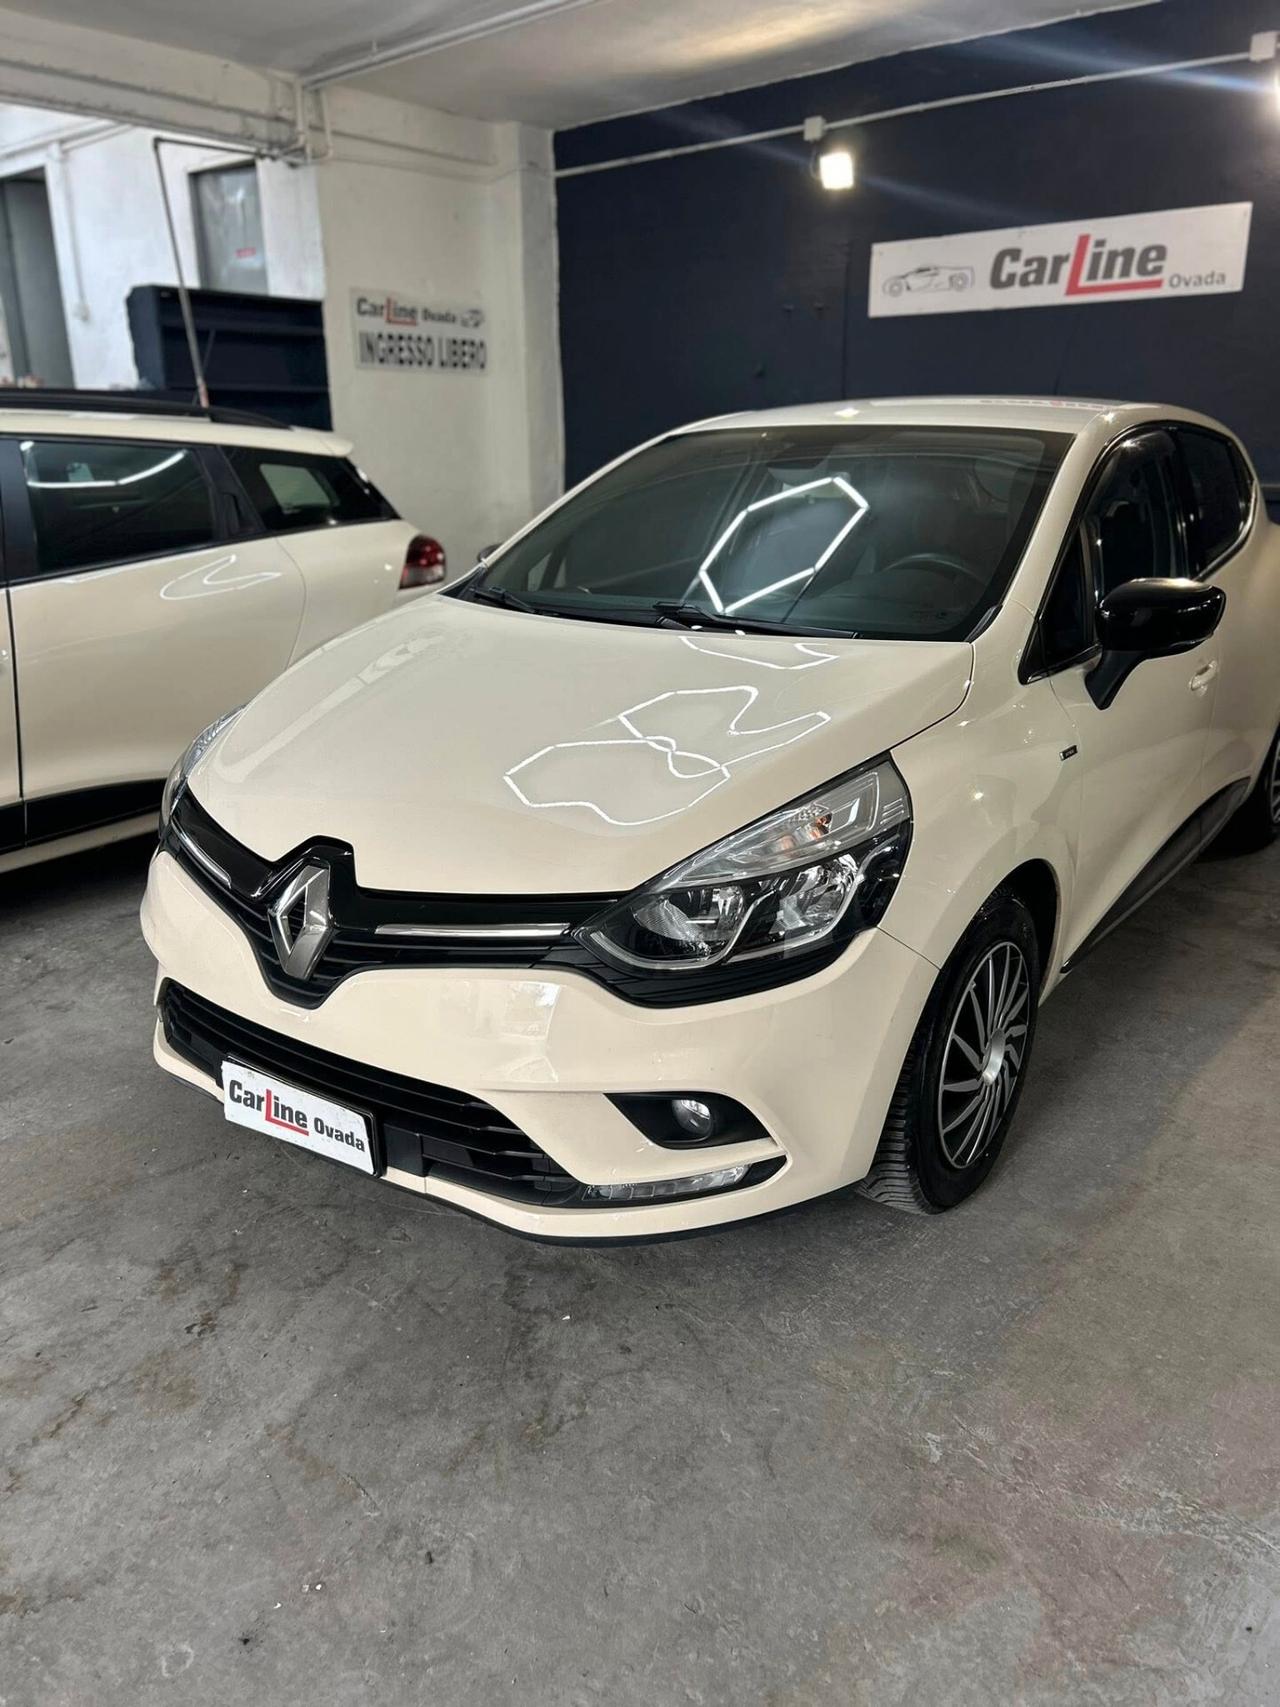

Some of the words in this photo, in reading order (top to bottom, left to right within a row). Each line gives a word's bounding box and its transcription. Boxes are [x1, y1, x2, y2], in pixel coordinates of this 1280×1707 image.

[990, 234, 1167, 295] CarLine
[1169, 270, 1226, 288] Ovada
[357, 298, 417, 326] CarLine
[360, 332, 434, 366] INGRESSO
[439, 338, 486, 370] LIBERO
[229, 1079, 309, 1136] CarLine
[314, 1117, 365, 1152] Ovada
